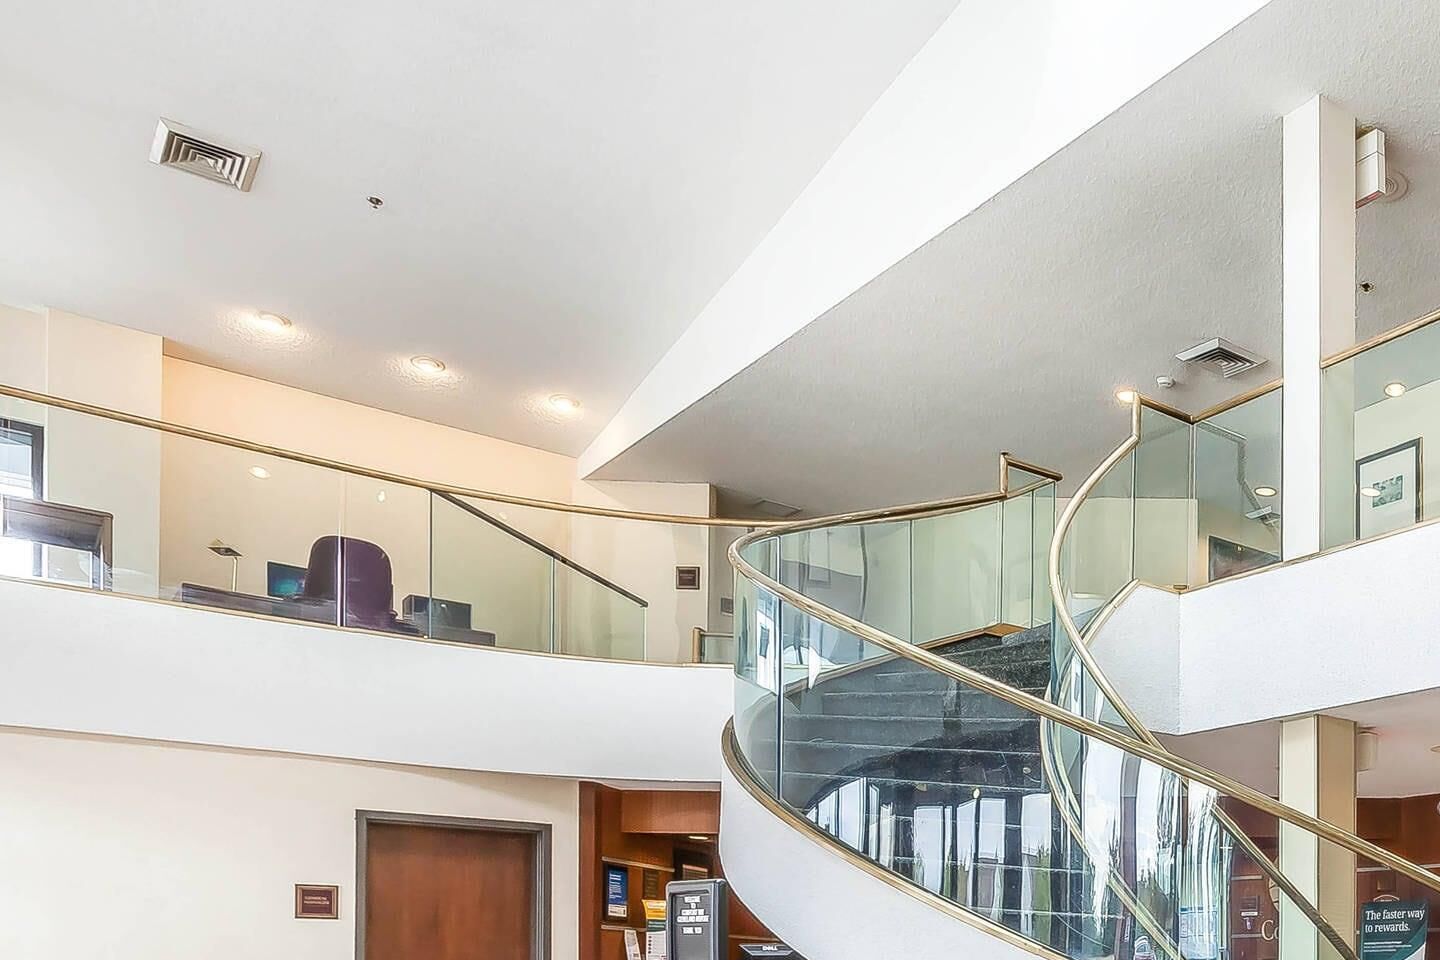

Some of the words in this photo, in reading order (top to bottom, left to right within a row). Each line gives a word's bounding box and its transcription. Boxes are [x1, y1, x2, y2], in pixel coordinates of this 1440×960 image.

[1365, 910, 1381, 920] The
[1382, 910, 1406, 920] faster
[1407, 910, 1425, 920] way
[1365, 924, 1373, 933] to
[1374, 921, 1410, 933] rewards.
